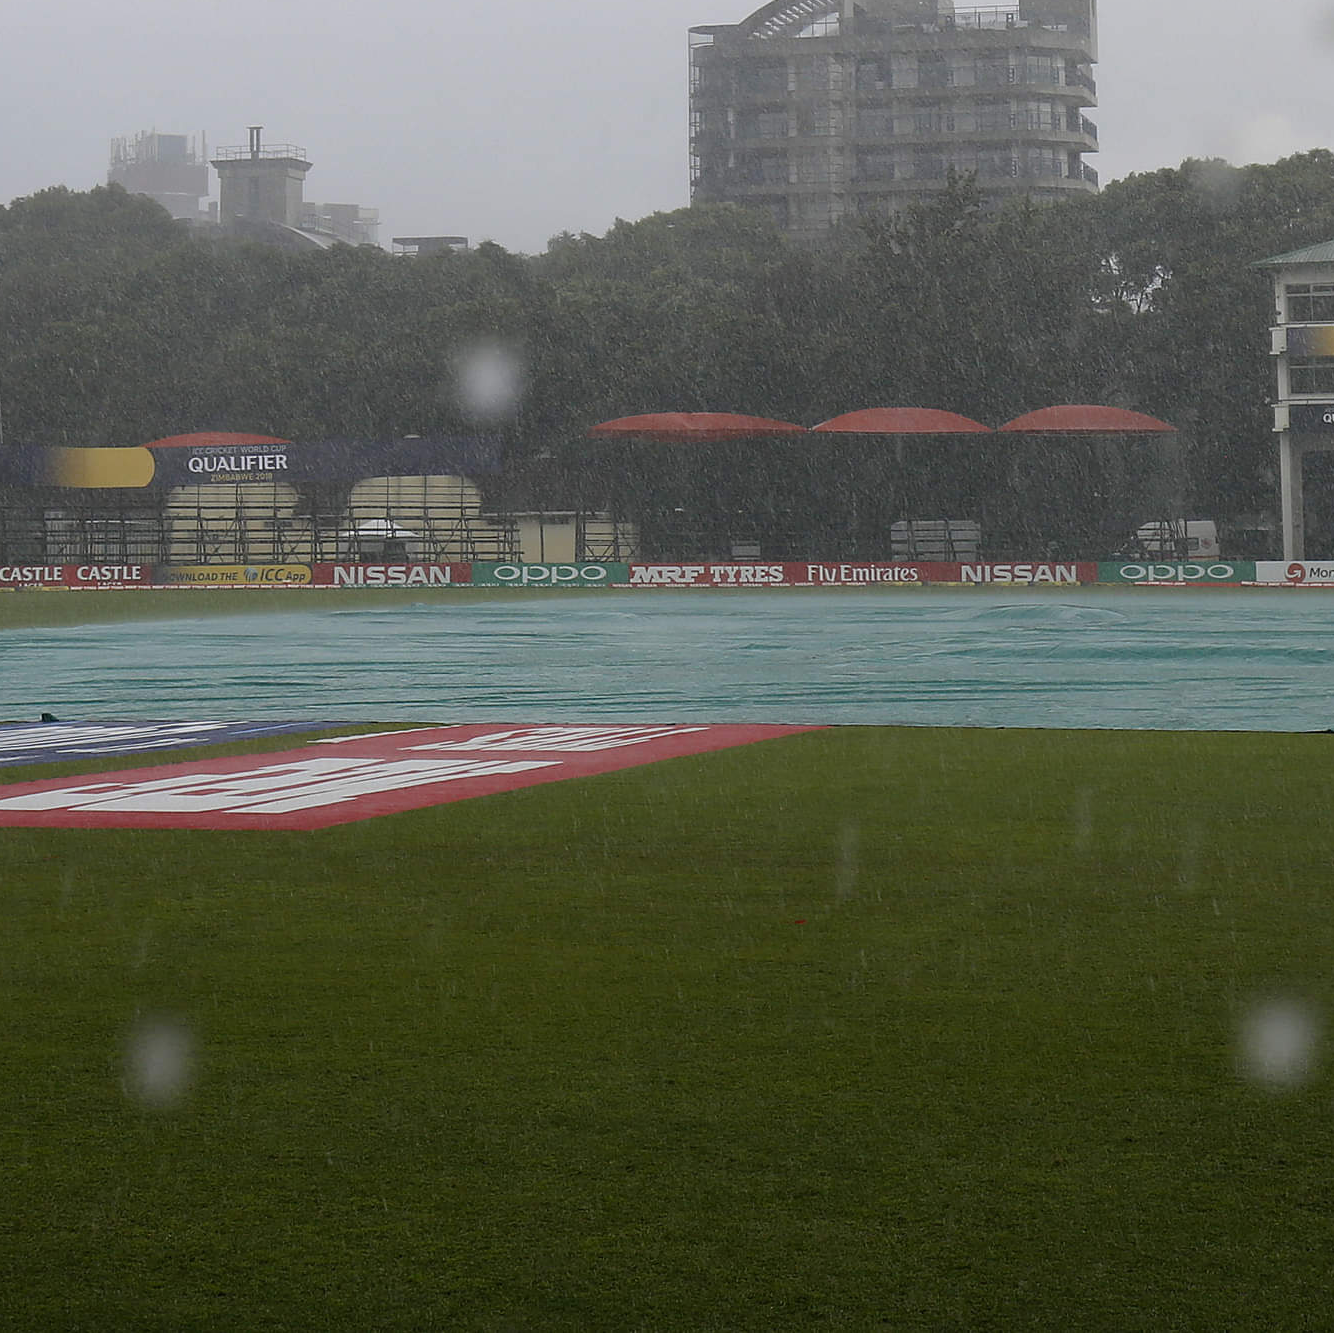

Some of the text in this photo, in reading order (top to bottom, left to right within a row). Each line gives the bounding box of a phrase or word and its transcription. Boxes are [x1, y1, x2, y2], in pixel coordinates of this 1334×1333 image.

[241, 445, 269, 453] WORLD
[271, 444, 286, 453] CUP
[188, 454, 288, 473] QUALIFIER
[211, 473, 253, 482] ZIMBABWE
[77, 566, 141, 580] CASTLE
[220, 572, 238, 581] THE
[260, 568, 285, 581] ICC
[333, 566, 451, 584] NISSAN
[493, 566, 607, 583] oppo
[629, 566, 784, 583] MRF TYRES
[807, 565, 918, 582] Fly Emirates
[961, 565, 1076, 582] NISSAN
[1120, 565, 1234, 581] oppo
